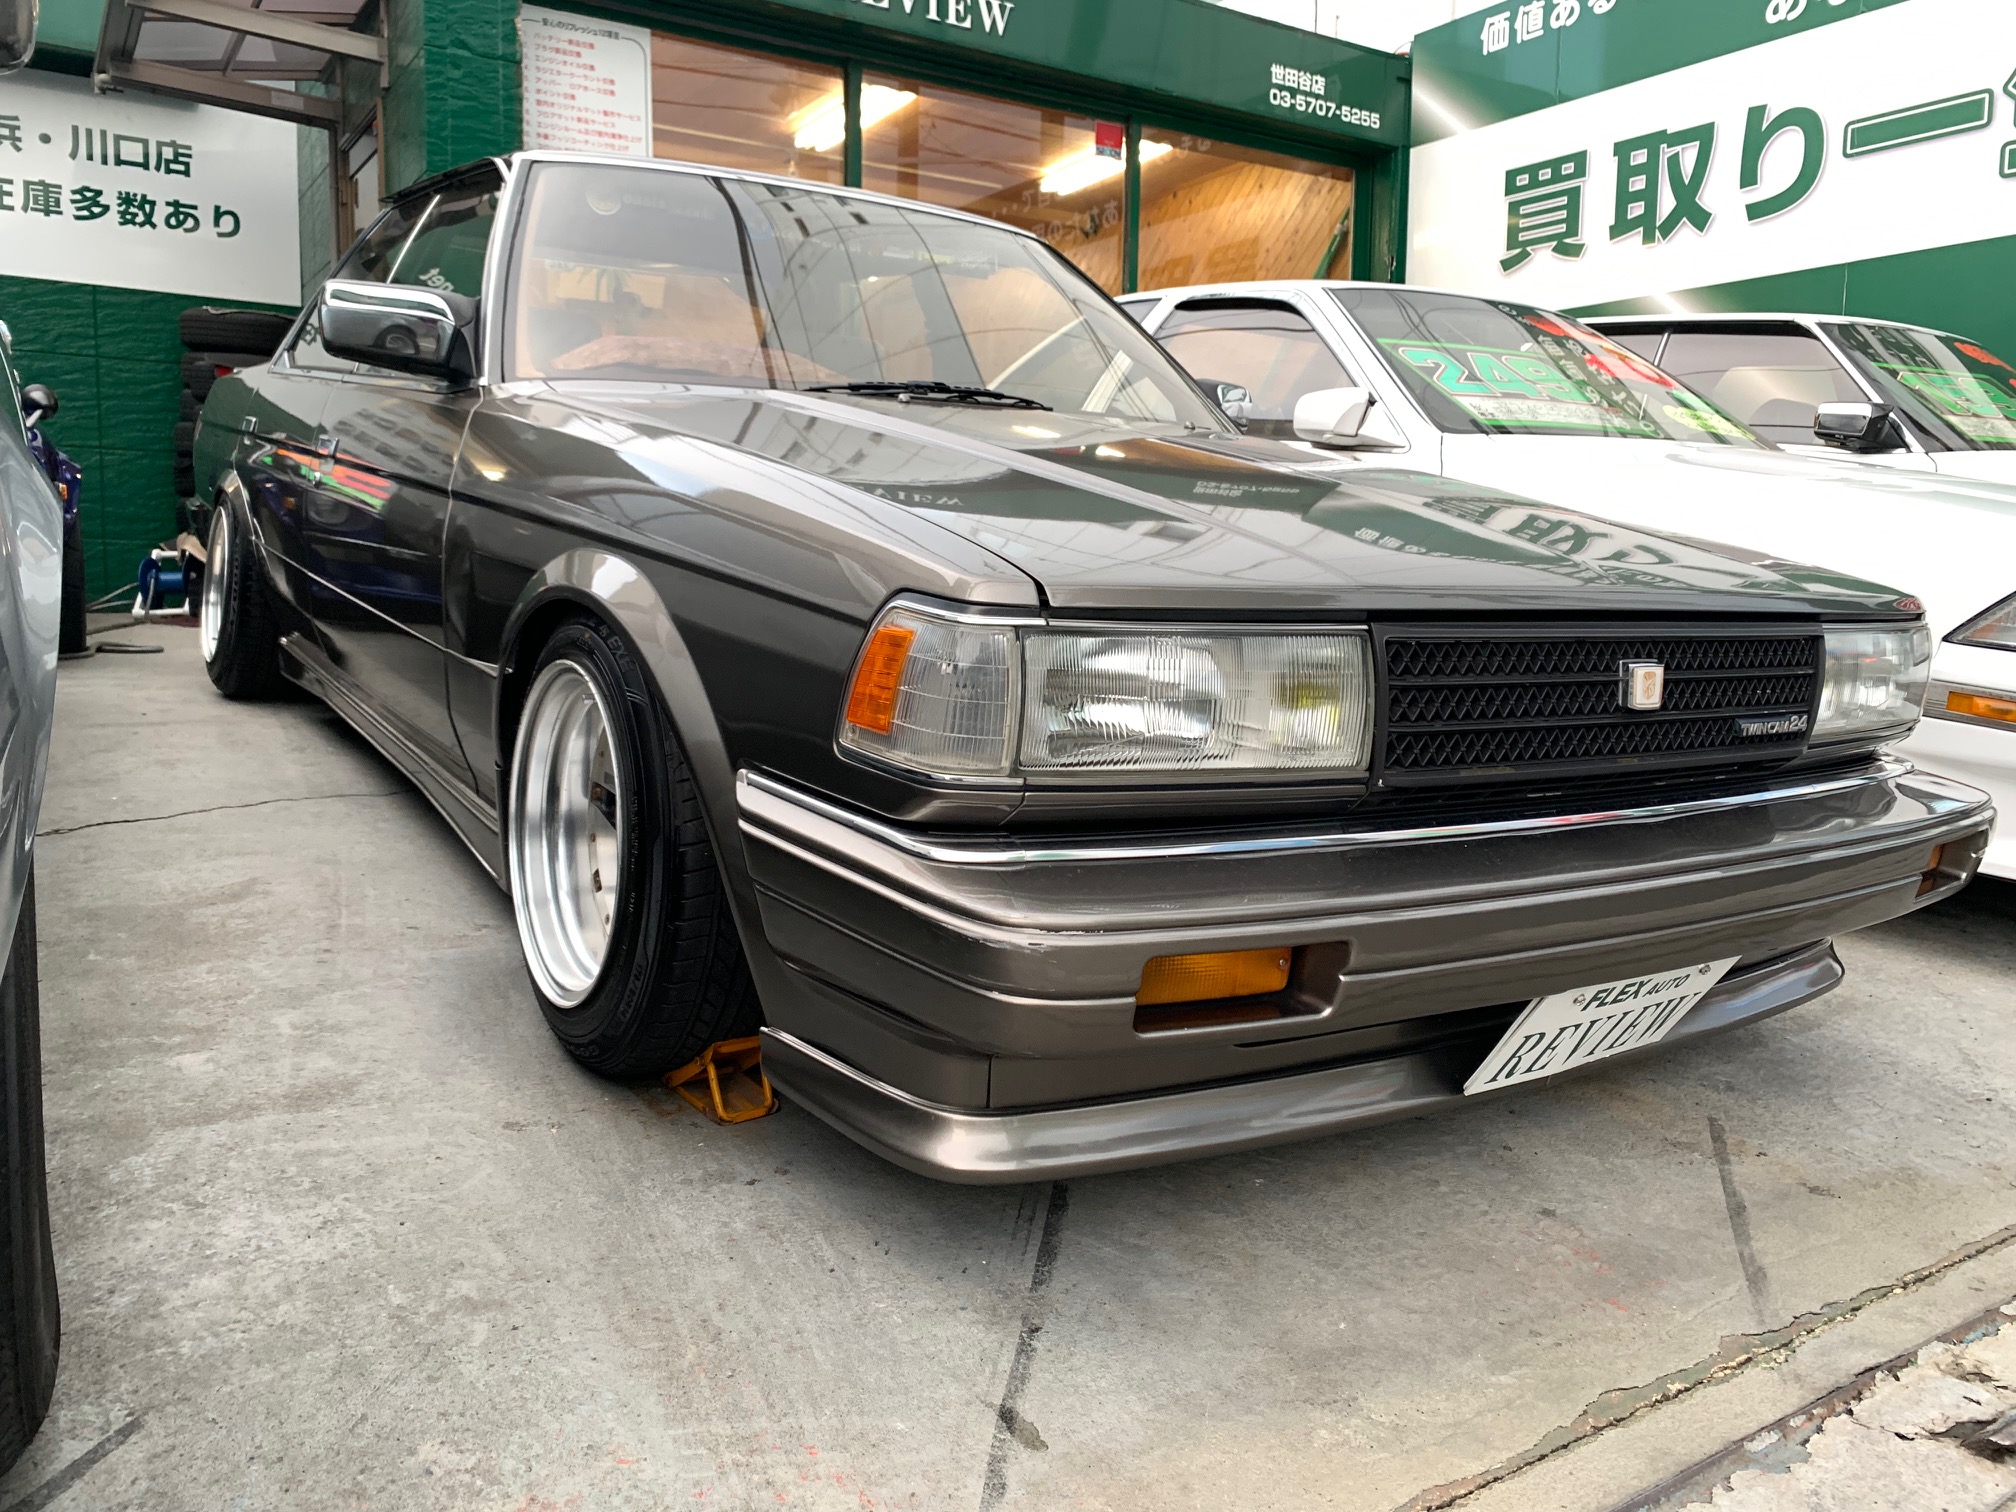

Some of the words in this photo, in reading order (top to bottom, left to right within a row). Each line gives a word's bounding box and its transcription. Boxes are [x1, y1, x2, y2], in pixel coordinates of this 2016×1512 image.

[1270, 62, 1326, 96] 世田谷店
[1269, 88, 1380, 130] 03-5707-5255
[1398, 346, 1597, 404] 249
[1580, 977, 1653, 1012] FLEX
[1645, 973, 1692, 997] AUTO
[1483, 991, 1702, 1085] REVIEW
